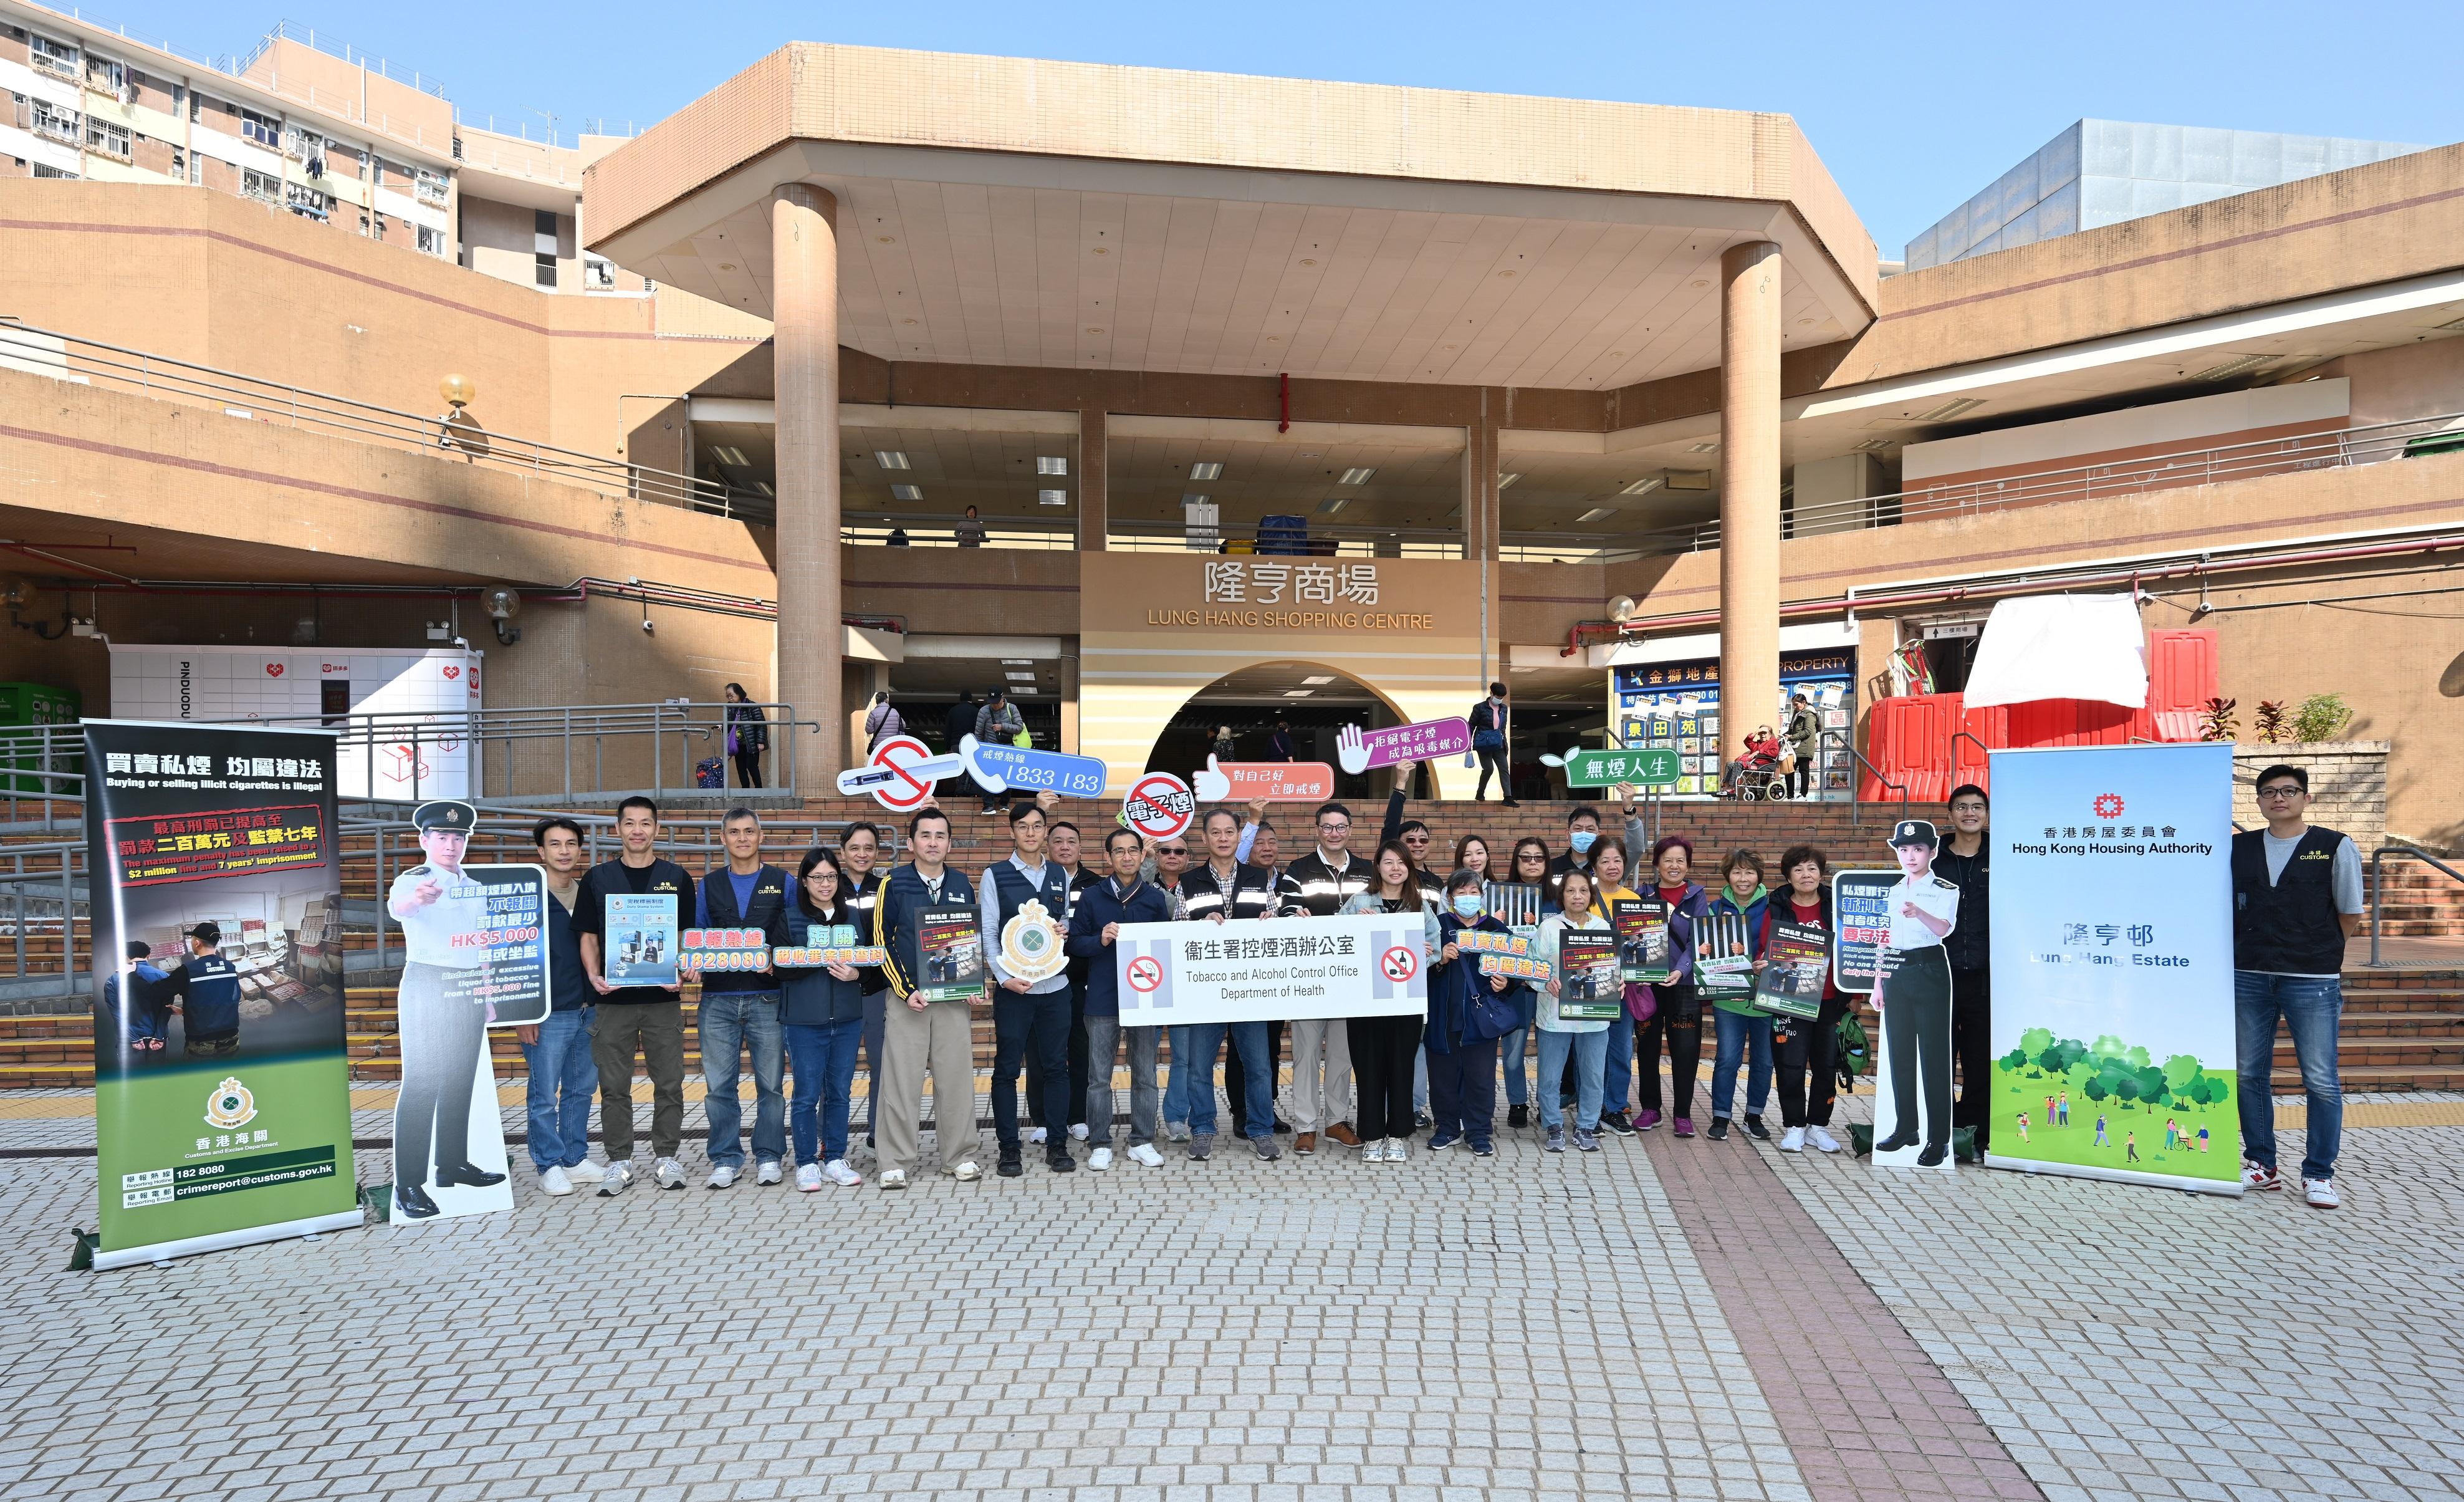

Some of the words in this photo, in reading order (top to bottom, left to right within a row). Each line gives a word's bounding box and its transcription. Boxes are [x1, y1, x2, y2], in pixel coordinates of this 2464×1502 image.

[1205, 561, 1378, 605] 隆亨商場
[1148, 609, 1199, 626] LUNG
[1205, 610, 1258, 627] HANG
[1263, 611, 1357, 628] SHOPPING
[1363, 613, 1433, 630] CENTRE
[1649, 665, 1719, 684] 金獅地產
[181, 662, 190, 720] PINDUODU
[1374, 727, 1437, 748] 拒絕電子煙
[1388, 737, 1464, 759] 成為吸毒媒介
[982, 750, 1025, 764] 戒煙熱線
[106, 753, 211, 776] 買賣私煙
[226, 756, 322, 779] 均屬違法
[1585, 757, 1668, 779] 無煙人生
[1007, 765, 1055, 786] 1833
[1063, 771, 1098, 791] 183
[1233, 769, 1285, 782] 對自己好
[107, 777, 145, 789] Buying
[148, 779, 160, 787] or
[162, 779, 198, 790] selling
[200, 779, 227, 789] illicit
[229, 780, 280, 792] cigarettes
[282, 781, 291, 790] is
[293, 781, 322, 792] illegal
[1268, 783, 1321, 796] 立即戒煙
[1126, 791, 1193, 822] 電子煙
[153, 814, 283, 835] 最高刑罰已提高至
[2043, 826, 2177, 839] 香港房屋委員會
[118, 826, 318, 856] 罰款二百萬元及監禁七年
[123, 859, 140, 868] The
[143, 855, 191, 867] maximum
[193, 852, 227, 864] penalty
[229, 850, 245, 859] has
[247, 848, 269, 857] been
[271, 845, 299, 855] raised
[300, 844, 309, 852] to
[2012, 843, 2047, 857] Hong
[2051, 843, 2086, 857] Kong
[2089, 843, 2145, 857] Housing
[2148, 843, 2212, 857] Authority
[128, 870, 142, 879] $2
[144, 867, 177, 877] million
[179, 865, 197, 874] fine
[199, 862, 216, 872] and
[218, 861, 225, 869] 7
[227, 859, 254, 870] years'
[256, 852, 317, 865] imprisonment
[451, 882, 537, 898] 帶超額煙酒入境
[1842, 885, 1889, 898] 私煙罪行
[489, 895, 538, 912] 不報關
[1842, 898, 1889, 914] 新刑責
[477, 912, 538, 930] 罰款最少
[1843, 915, 1891, 928] 違者必究
[450, 927, 539, 948] HK$5,000
[684, 930, 764, 949] 舉報熱線
[810, 927, 853, 946] 海關
[1458, 932, 1528, 955] 買賣私煙
[1843, 927, 1891, 944] 要守法
[2063, 923, 2154, 948] 隆亨邨
[477, 945, 538, 963] 甚或坐監
[1843, 945, 1858, 954] New
[1858, 946, 1889, 955] penalties
[679, 953, 767, 969] 1828080
[1481, 956, 1551, 980] 均屬違法
[2030, 951, 2072, 967] Lung
[2079, 953, 2124, 967] Hang
[2132, 953, 2190, 968] Estate
[442, 967, 495, 980] Undeclared
[499, 964, 539, 973] excessive
[495, 975, 529, 983] tobacco
[1186, 970, 1227, 983] Tobacco
[1230, 970, 1247, 981] and
[1252, 968, 1287, 980] Alcohol
[1291, 966, 1326, 979] Control
[1329, 965, 1358, 977] Office
[1843, 968, 1861, 977] defy
[473, 983, 522, 996] HK$5,000
[485, 991, 540, 1003] imprisonment
[1221, 987, 1277, 1001] Department
[1280, 986, 1290, 997] of
[1293, 984, 1325, 996] Health
[196, 1129, 268, 1150] 香港海關
[245, 1141, 279, 1152] Department
[127, 1171, 171, 1183] 舉報熱線
[176, 1168, 196, 1179] 182
[199, 1164, 225, 1176] 8080
[176, 1163, 332, 1196] crimereport@customs.gov.hk
[127, 1180, 153, 1189] Reporting
[155, 1177, 173, 1185] Hotline
[127, 1198, 155, 1208] Reporting
[156, 1195, 173, 1203] Email
[128, 1188, 172, 1201] 舉報電郵
